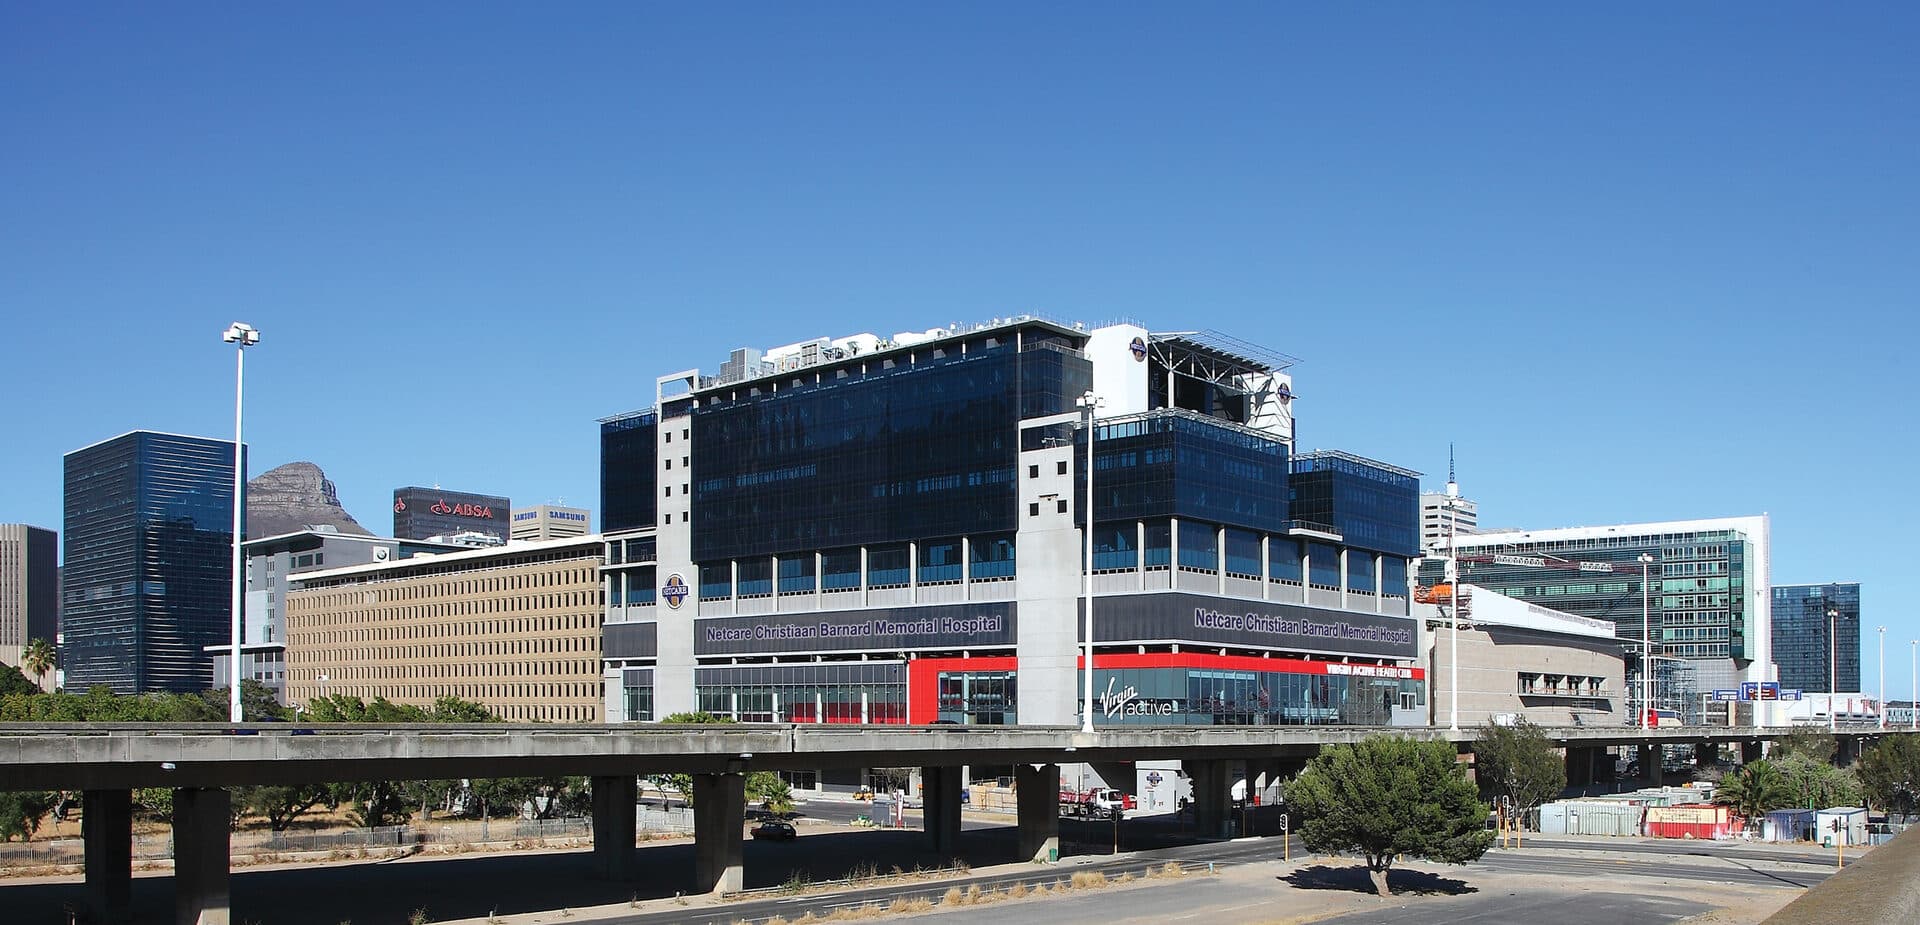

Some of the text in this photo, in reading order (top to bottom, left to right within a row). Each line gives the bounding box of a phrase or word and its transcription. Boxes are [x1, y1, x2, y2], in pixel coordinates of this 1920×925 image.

[453, 503, 494, 519] ABSA
[513, 511, 538, 522] SAMSUNG
[549, 511, 586, 522] SAMSUNG
[706, 615, 1002, 641] Netcare Christiaan Barnard Memorial Hospital
[1194, 608, 1411, 646] Netcare Christiaan Barnard Memorial Hospital
[1326, 663, 1351, 675] VIRGIN
[1352, 665, 1376, 677] ACTIVE
[1099, 677, 1139, 720] Virgin
[1126, 699, 1172, 716] active
